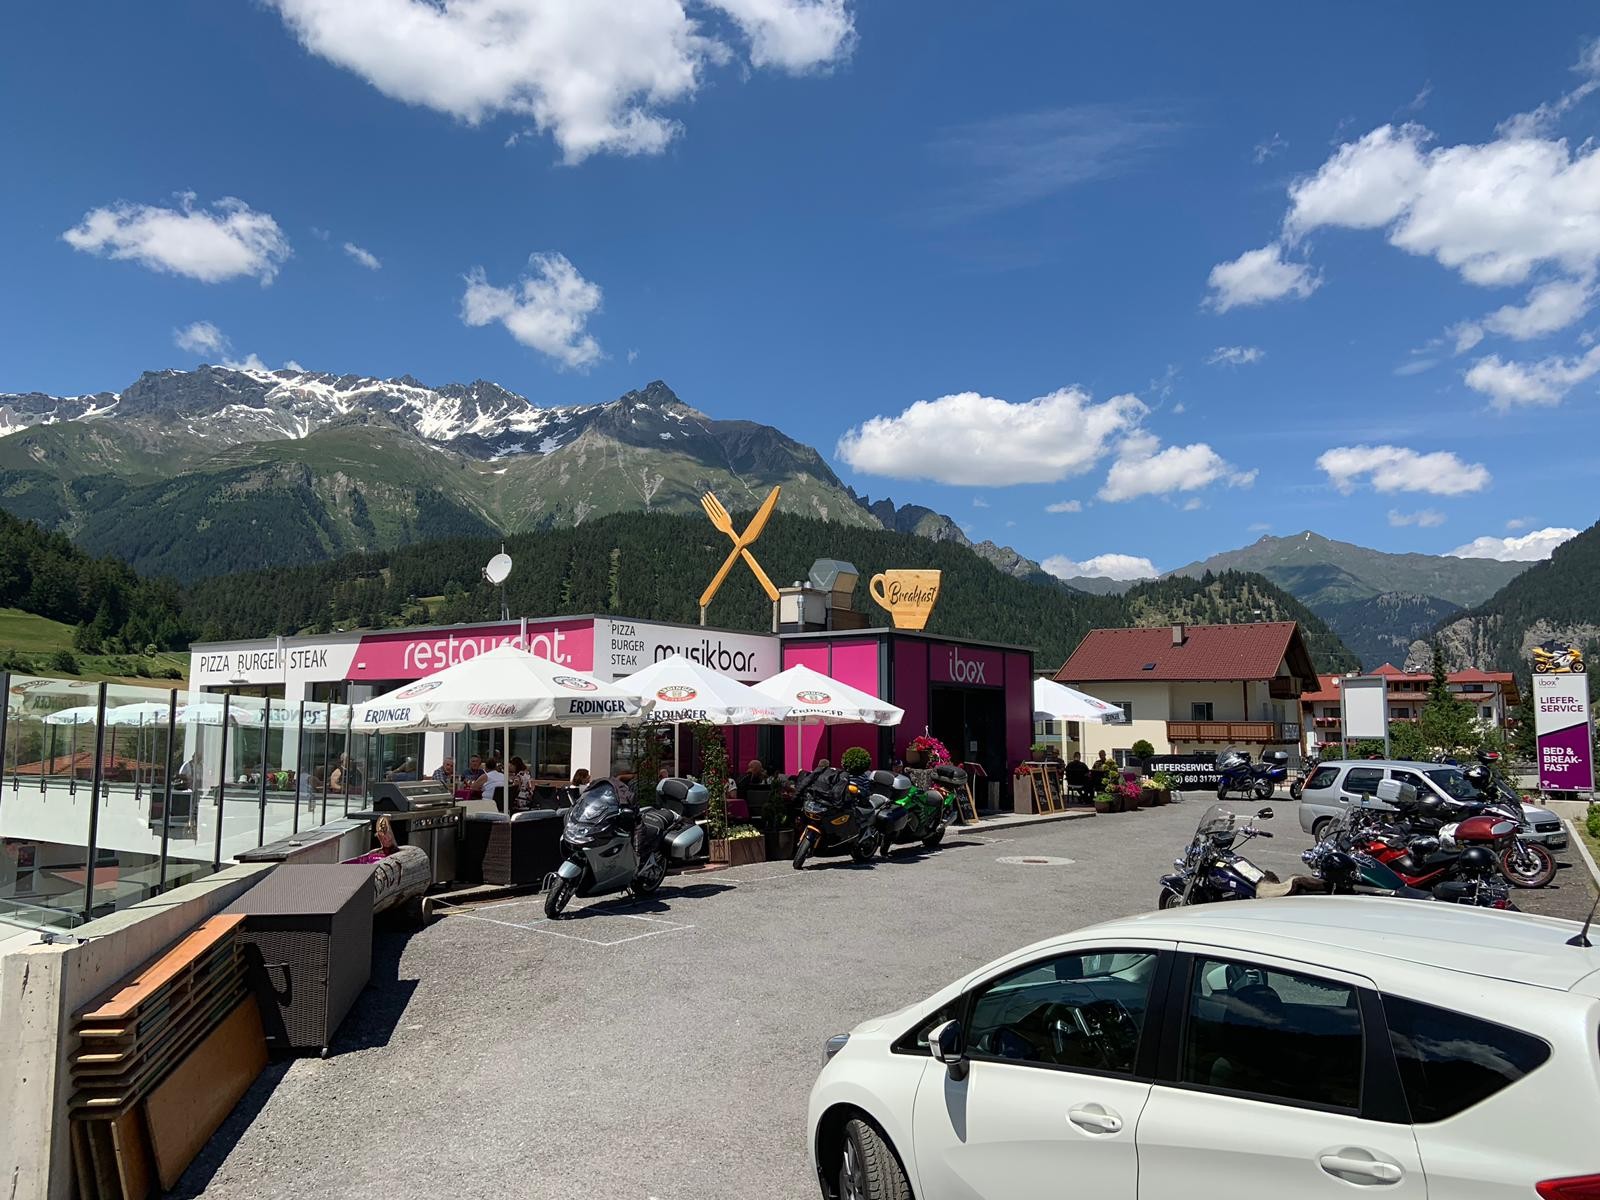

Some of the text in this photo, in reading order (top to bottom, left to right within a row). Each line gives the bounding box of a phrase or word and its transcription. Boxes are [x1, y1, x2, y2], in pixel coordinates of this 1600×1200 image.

[888, 580, 937, 607] Breakfast
[611, 624, 636, 636] PIZZA
[404, 628, 572, 670] restant.
[611, 639, 645, 652] BURGER
[200, 655, 230, 673] PIZZA
[290, 649, 328, 669] STEAK
[611, 654, 638, 666] STEAK
[467, 702, 518, 717] Weißbier
[569, 699, 627, 714] ERDINGER
[364, 707, 411, 723] ERDINGER
[647, 709, 707, 721] ERDINGER
[1543, 747, 1574, 755] BED &
[1543, 755, 1582, 763] BREAK-
[1150, 763, 1214, 772] LIEFERSERVICE
[1544, 764, 1570, 772] FAST
[1184, 774, 1198, 783] 660
